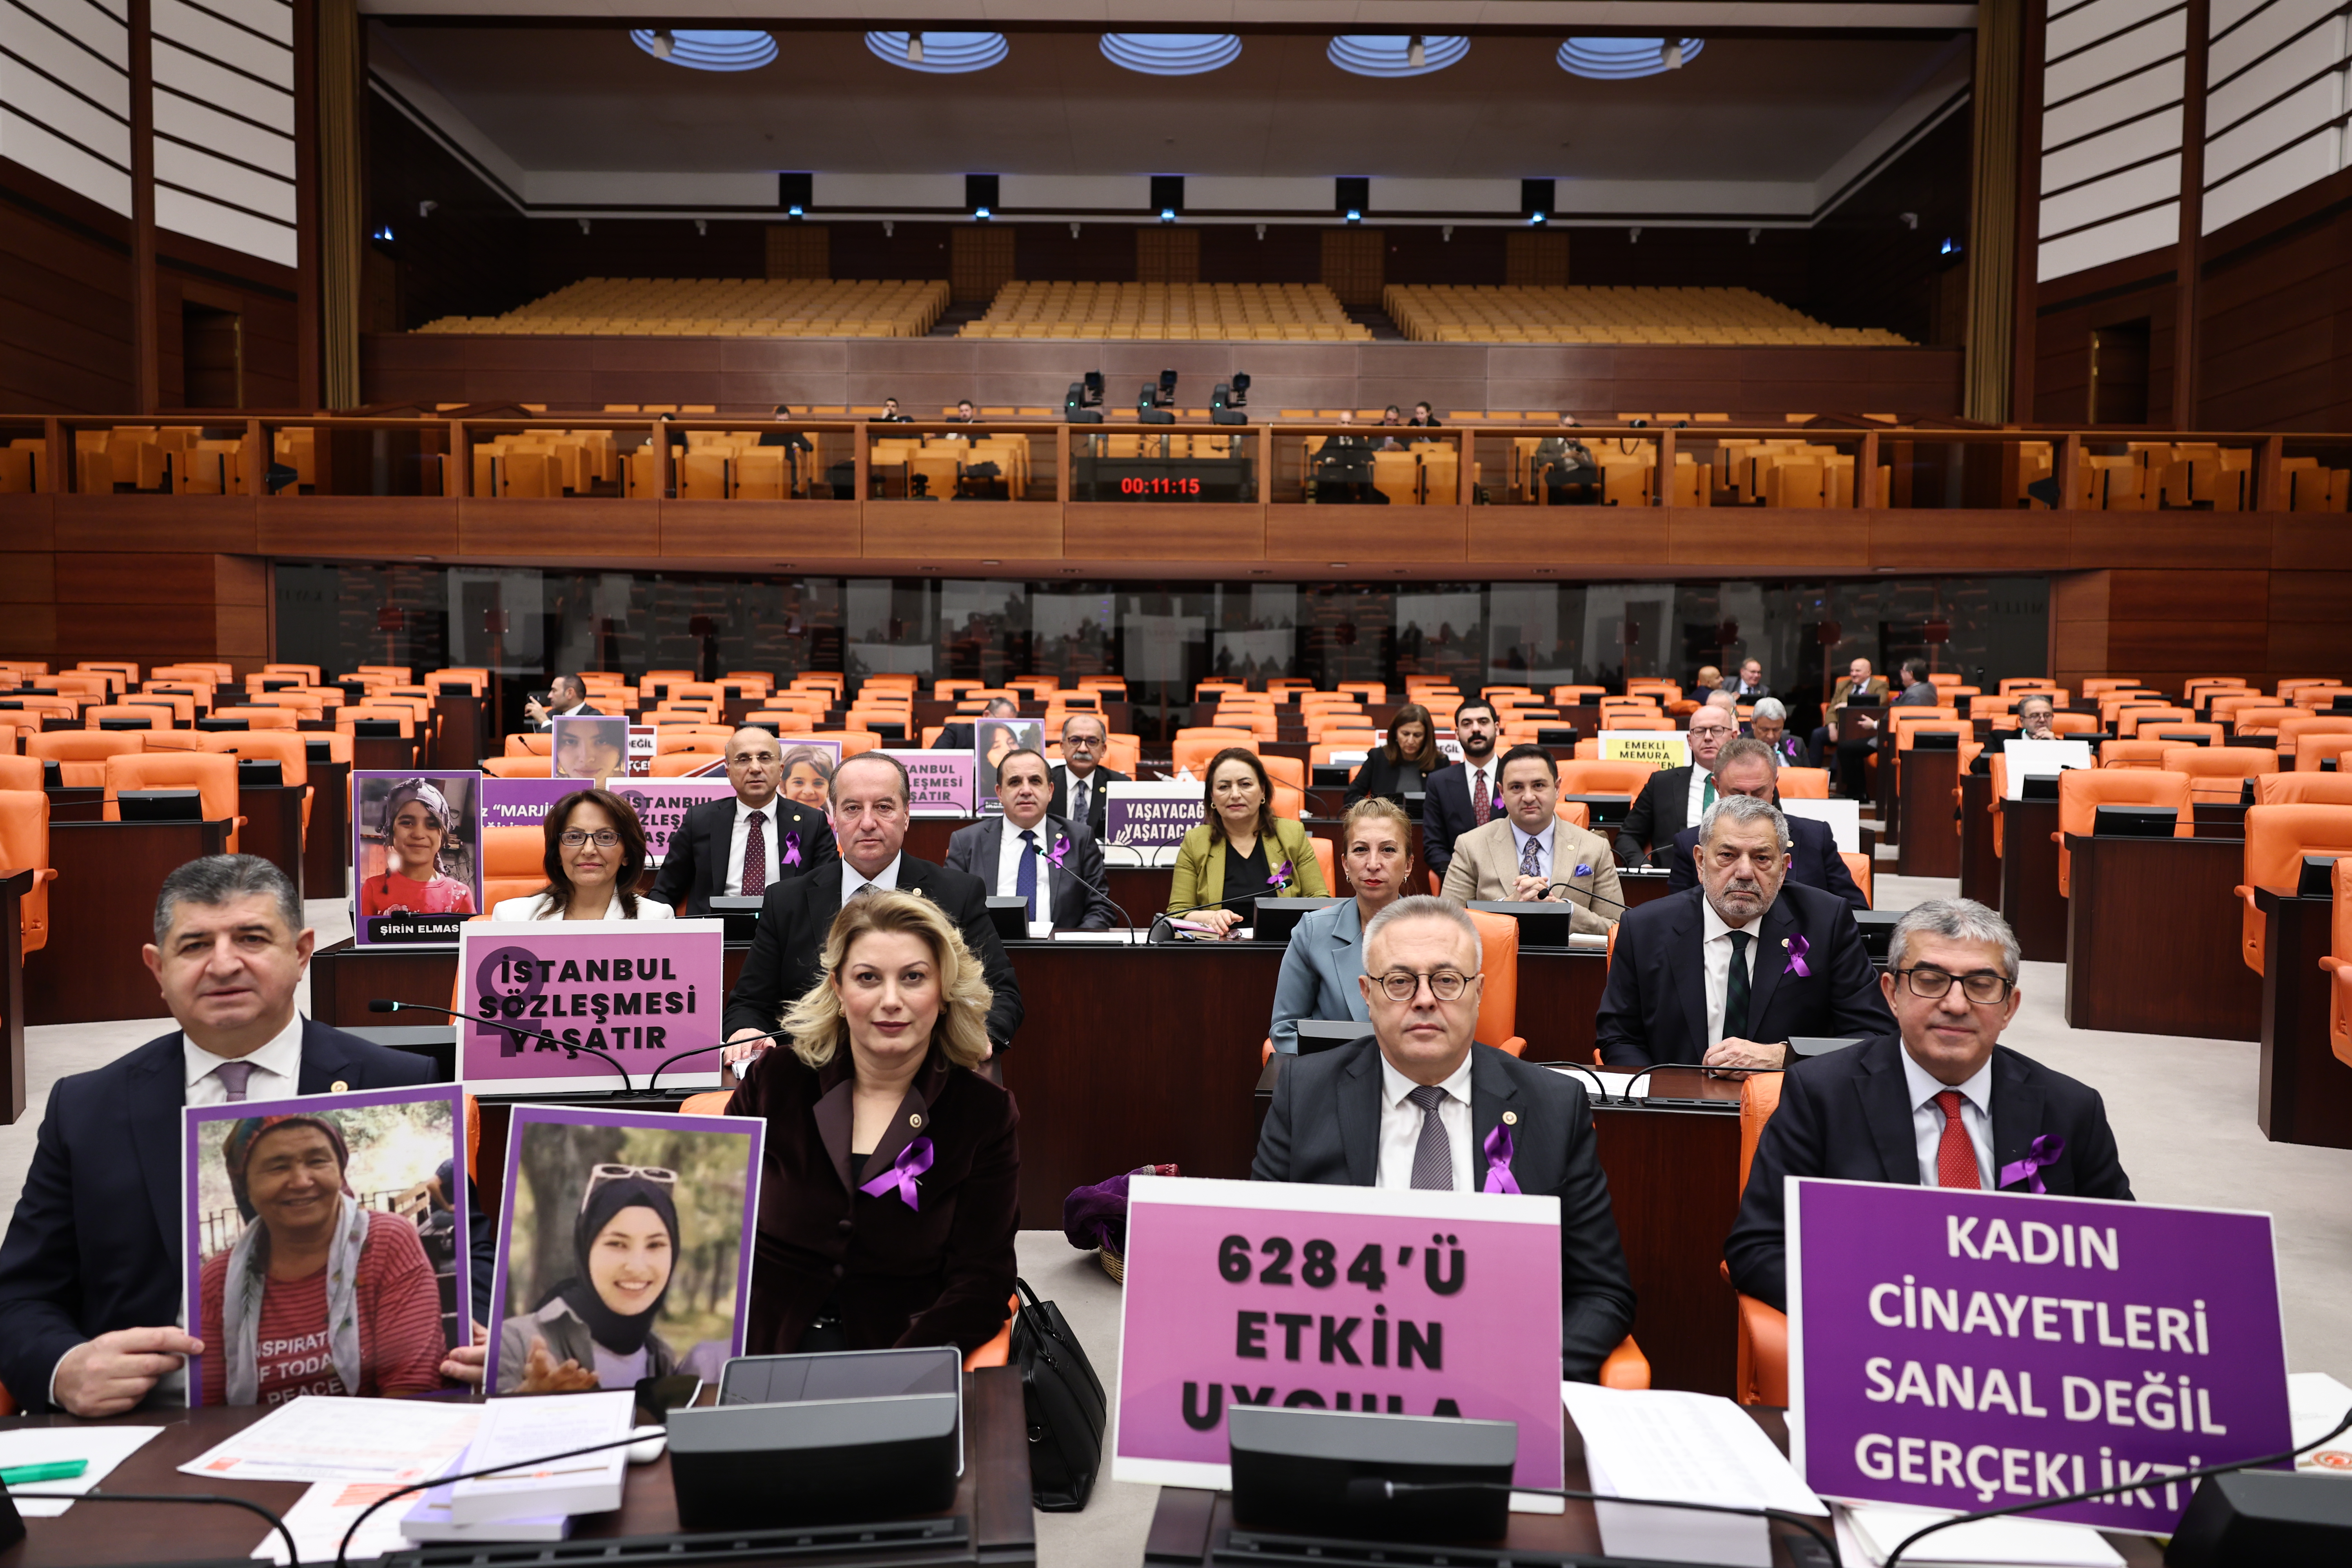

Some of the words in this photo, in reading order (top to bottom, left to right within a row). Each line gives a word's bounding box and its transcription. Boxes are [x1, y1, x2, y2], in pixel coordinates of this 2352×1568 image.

[1122, 478, 1200, 494] 00:11:15
[629, 739, 653, 748] EĞİL
[1620, 751, 1670, 759] MEMURA
[1625, 740, 1665, 750] EMEKLİ
[909, 776, 963, 790] EŞMESİ
[493, 802, 554, 817] “MARJİ
[910, 792, 951, 803] ŞATIR
[1126, 801, 1205, 821] YAŞAYACAĞ
[380, 924, 414, 936] ŞİRİN
[418, 925, 459, 933] ELMAS
[501, 954, 677, 983] İSTANBUL
[479, 985, 696, 1024] SÖZLEŞMESİ
[510, 1026, 667, 1059] YAŞATIR
[1946, 1214, 2120, 1270] KADIN
[1868, 1275, 2210, 1355] CİNAYETLERİ
[1236, 1305, 1443, 1370] ETKİN
[259, 1365, 270, 1383] F
[277, 1353, 332, 1379] TODA
[267, 1377, 343, 1405] PEACE
[1865, 1357, 2047, 1417] SANAL
[2062, 1370, 2227, 1436] DEĞİL
[1854, 1434, 2203, 1512] GERÇEKLİKTİ
